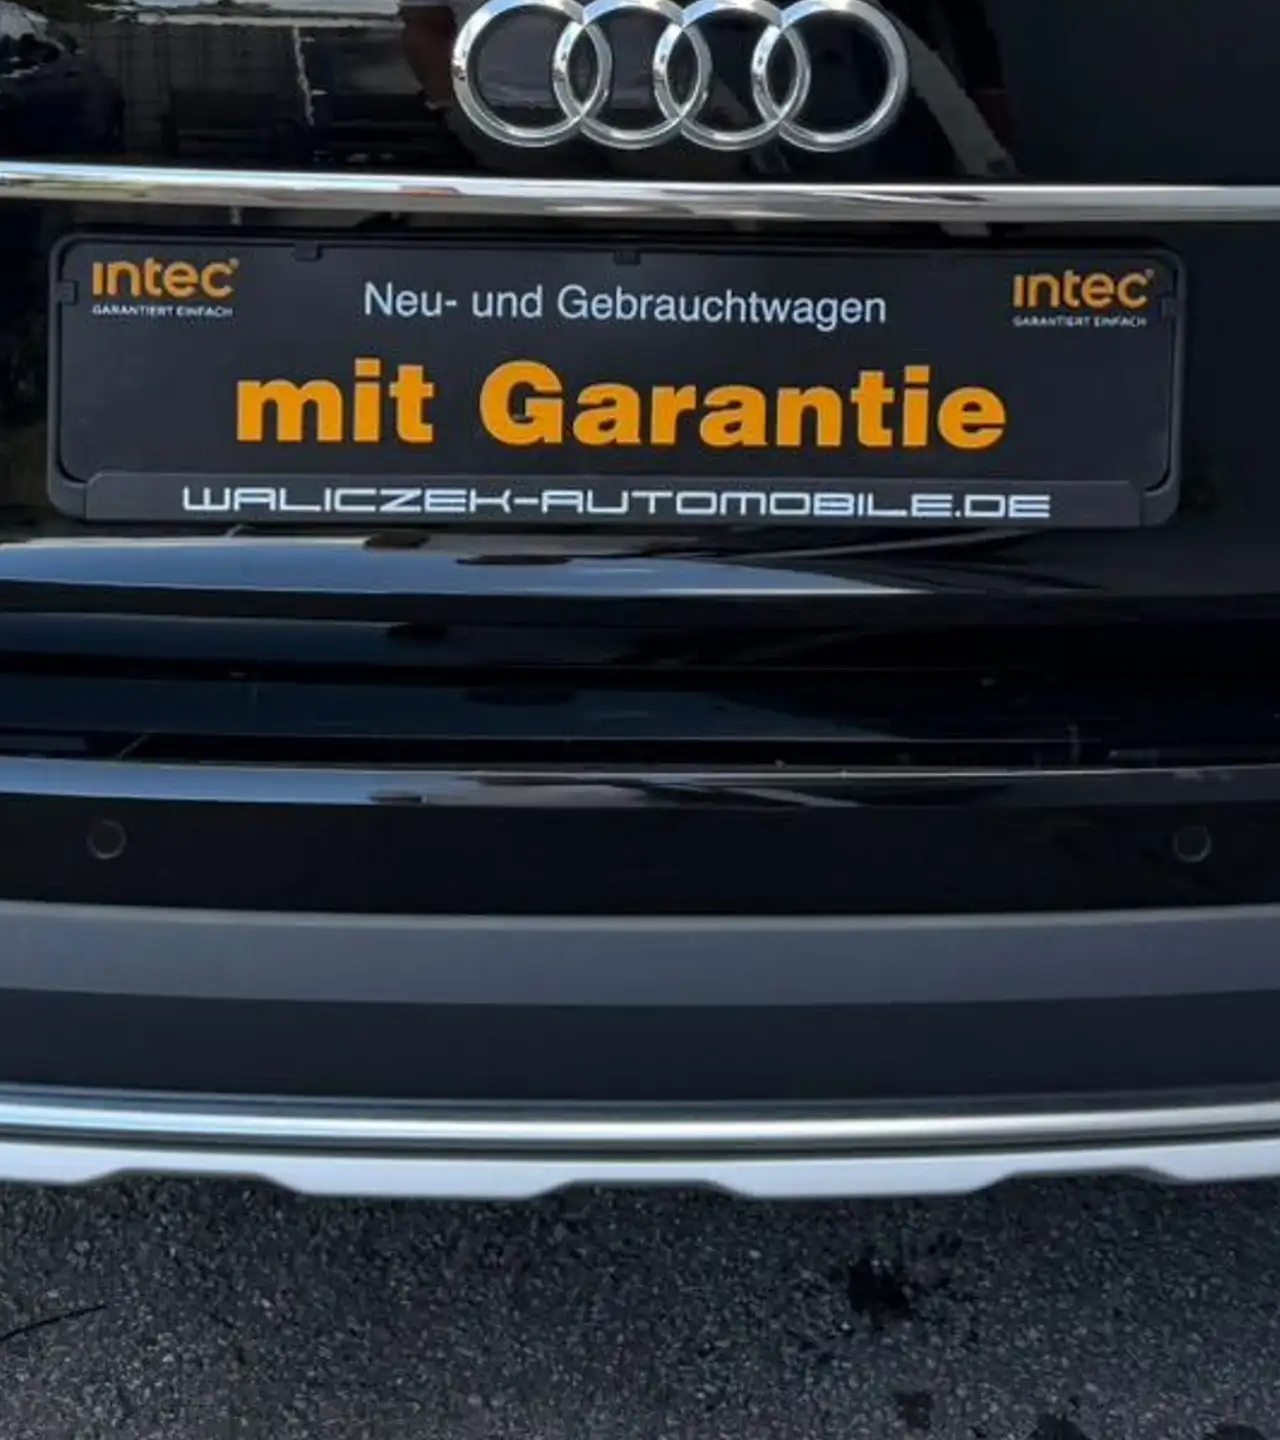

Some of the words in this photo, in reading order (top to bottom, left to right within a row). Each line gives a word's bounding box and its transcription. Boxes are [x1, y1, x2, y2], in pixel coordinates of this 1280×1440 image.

[92, 303, 173, 317] GARANTIERT
[176, 305, 234, 319] EINFACH
[364, 282, 458, 318] Neu-
[472, 284, 543, 319] und
[557, 283, 886, 333] Gebrauchtwagen
[1012, 315, 1090, 328] GARANTIERT
[1093, 315, 1148, 328] EINFACH
[236, 359, 435, 444] mit
[479, 360, 1006, 449] Garantie
[182, 486, 1051, 519] WALICZEK-AUTOMOBILE.DE
